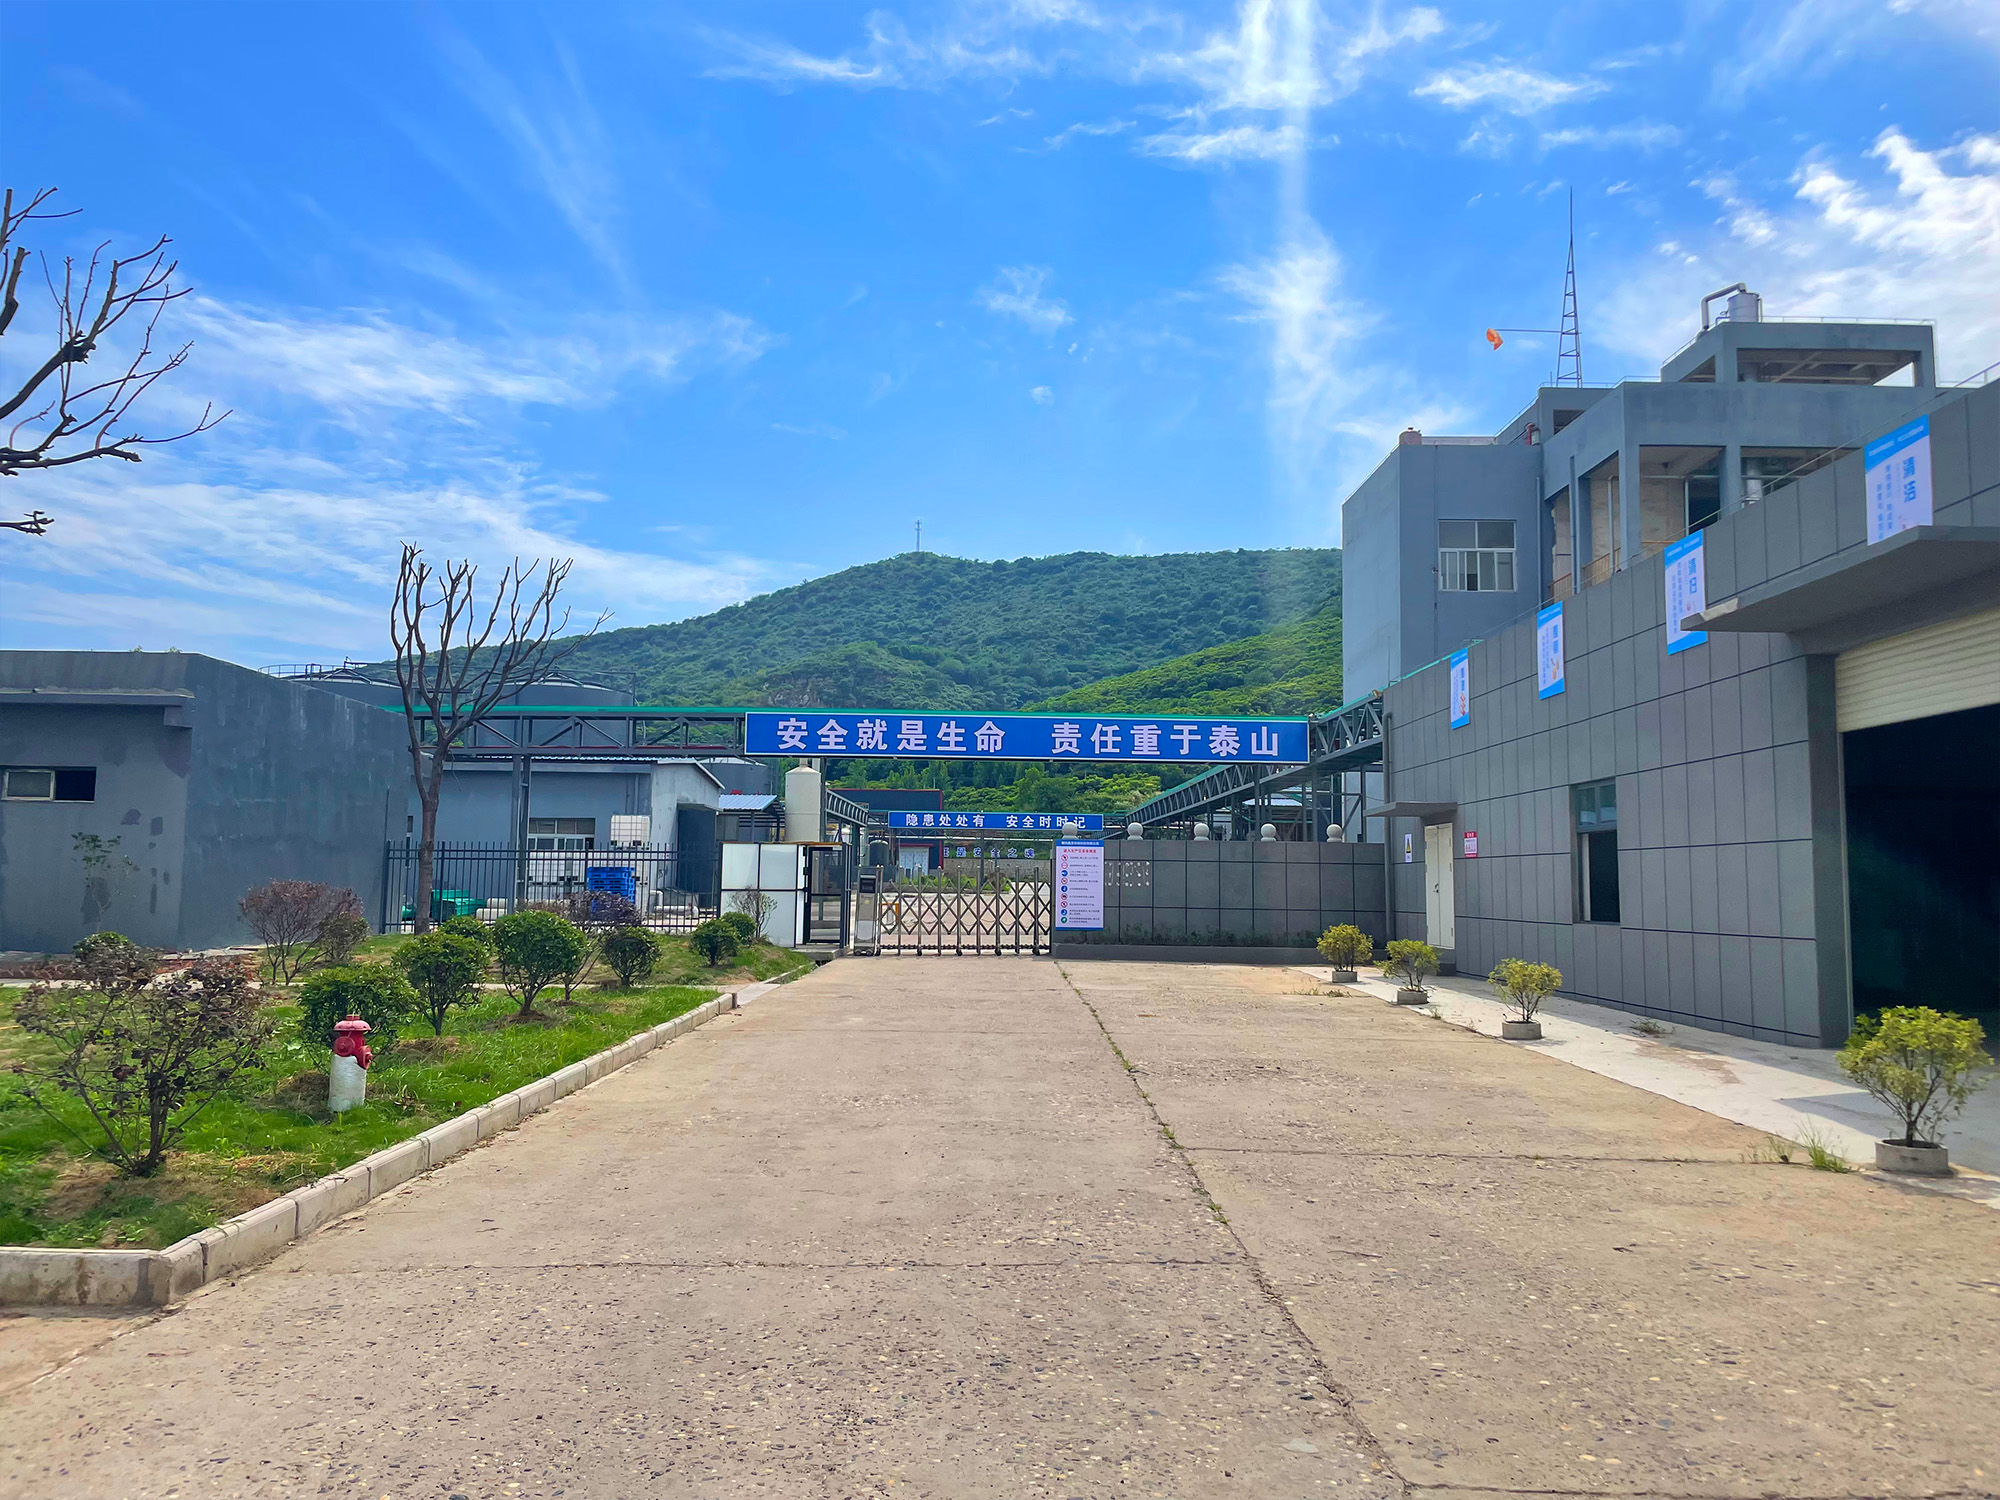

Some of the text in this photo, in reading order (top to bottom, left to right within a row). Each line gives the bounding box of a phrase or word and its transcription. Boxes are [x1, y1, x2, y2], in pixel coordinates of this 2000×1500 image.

[777, 718, 1278, 757] 安全就是生命 责任重于泰山
[906, 813, 1086, 829] 隐患处处有 安全时时记
